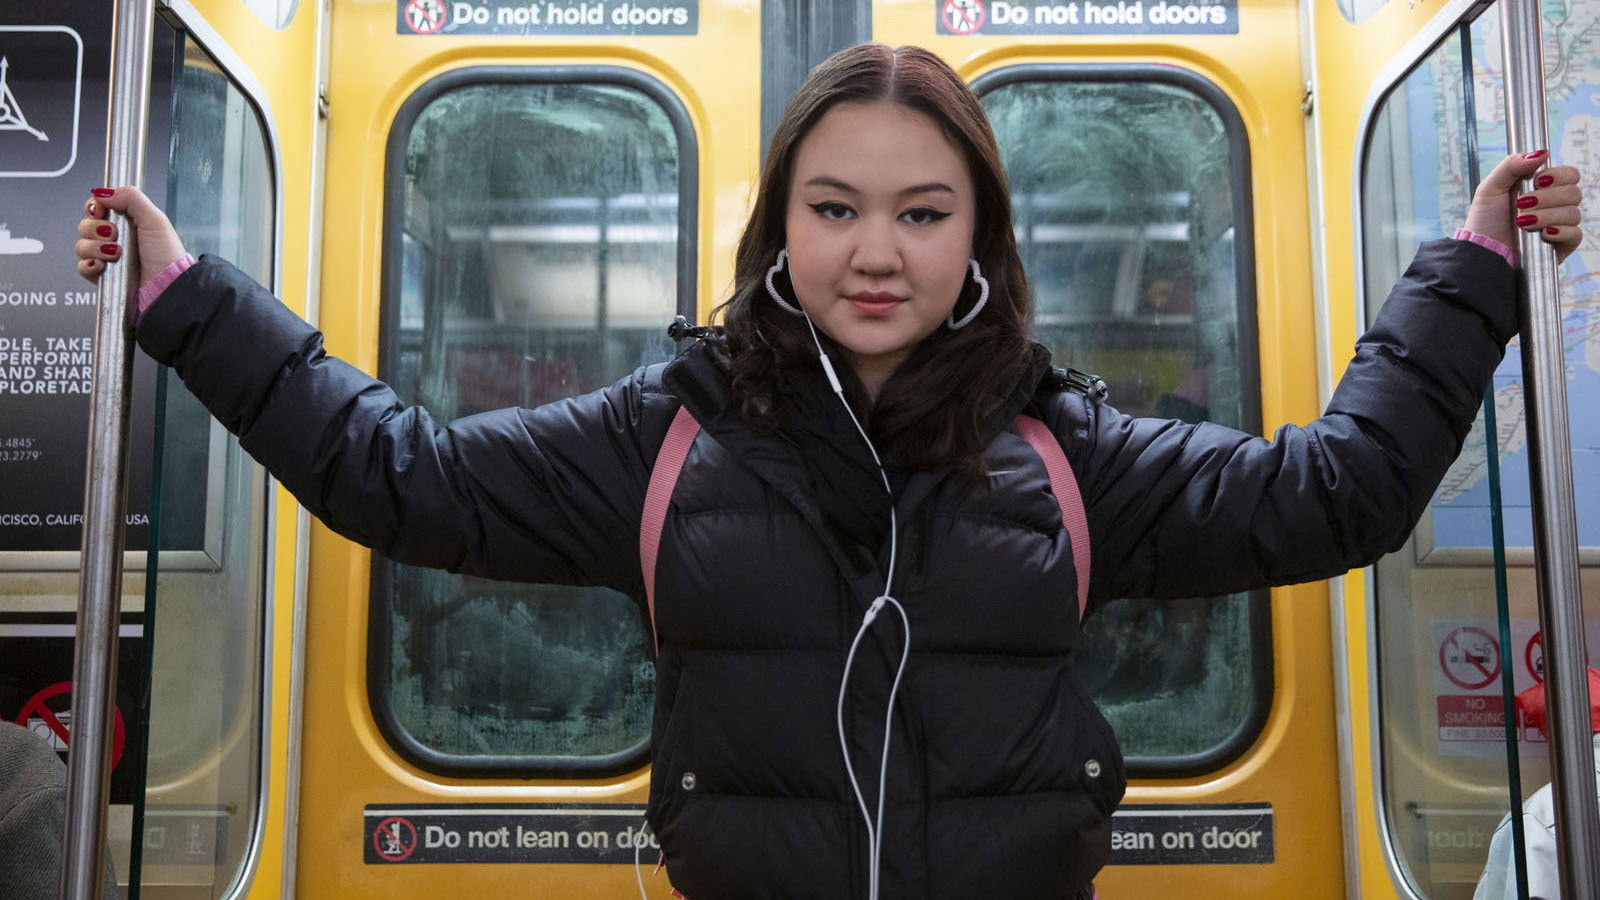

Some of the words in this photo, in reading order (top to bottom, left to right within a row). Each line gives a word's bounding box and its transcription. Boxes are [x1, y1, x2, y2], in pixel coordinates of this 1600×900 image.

[453, 4, 490, 25] Do
[497, 5, 541, 25] not
[547, 3, 604, 25] hold
[611, 3, 689, 25] doors
[991, 4, 1028, 25] Do
[1035, 5, 1080, 25] not
[1085, 3, 1143, 25] hold
[1149, 3, 1227, 25] doors
[46, 337, 92, 351] TAKE
[0, 366, 36, 380] AND
[43, 366, 92, 380] SHAR
[125, 514, 149, 525] USA
[1465, 698, 1486, 710] NO
[425, 825, 461, 848] Do
[468, 826, 509, 848] not
[516, 825, 568, 848] lean
[576, 829, 608, 848] on
[1162, 831, 1194, 849] on
[1201, 826, 1262, 848] door
